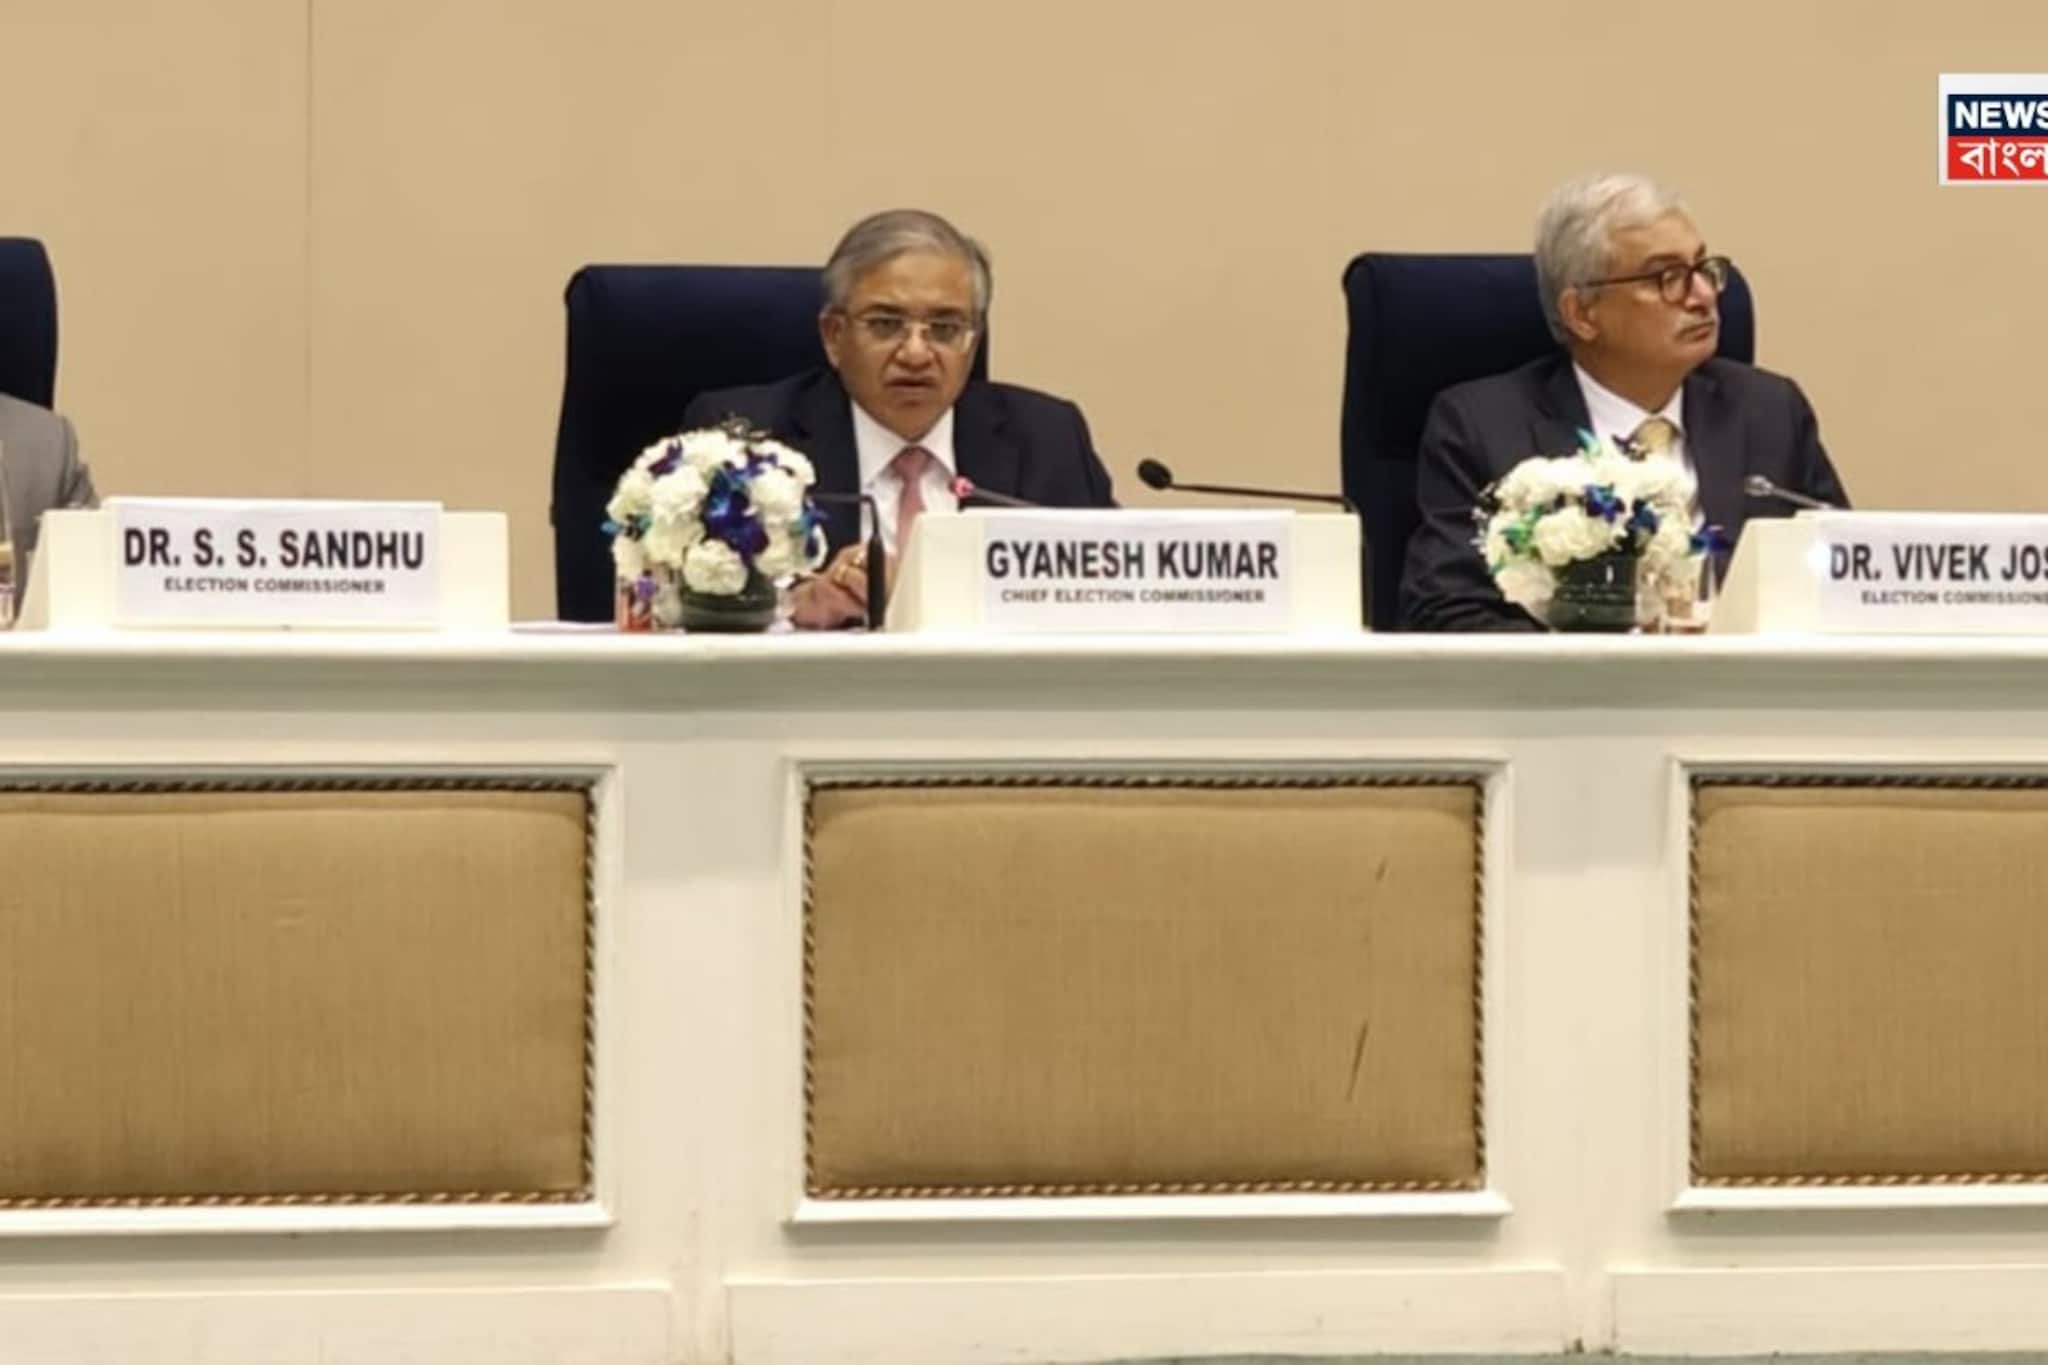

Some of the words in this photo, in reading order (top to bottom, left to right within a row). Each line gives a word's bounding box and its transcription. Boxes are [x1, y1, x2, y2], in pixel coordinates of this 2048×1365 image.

[124, 527, 181, 567] DR.
[193, 528, 225, 567] S.
[236, 529, 268, 568] S.
[279, 530, 425, 570] SANDHU
[986, 541, 1145, 580] GYANESH
[1157, 541, 1279, 580] KUMAR
[1829, 543, 1883, 581] DR.
[1892, 543, 1990, 582] VIVEK
[2001, 544, 2048, 582] JO
[164, 577, 249, 593] ELECTION
[254, 578, 386, 594] COMMISSIONER
[1001, 588, 1048, 604] CHIEF
[1055, 589, 1134, 604] ELECTION
[1140, 588, 1265, 604] COMMISSIONER
[1861, 590, 1939, 605] ELECTION
